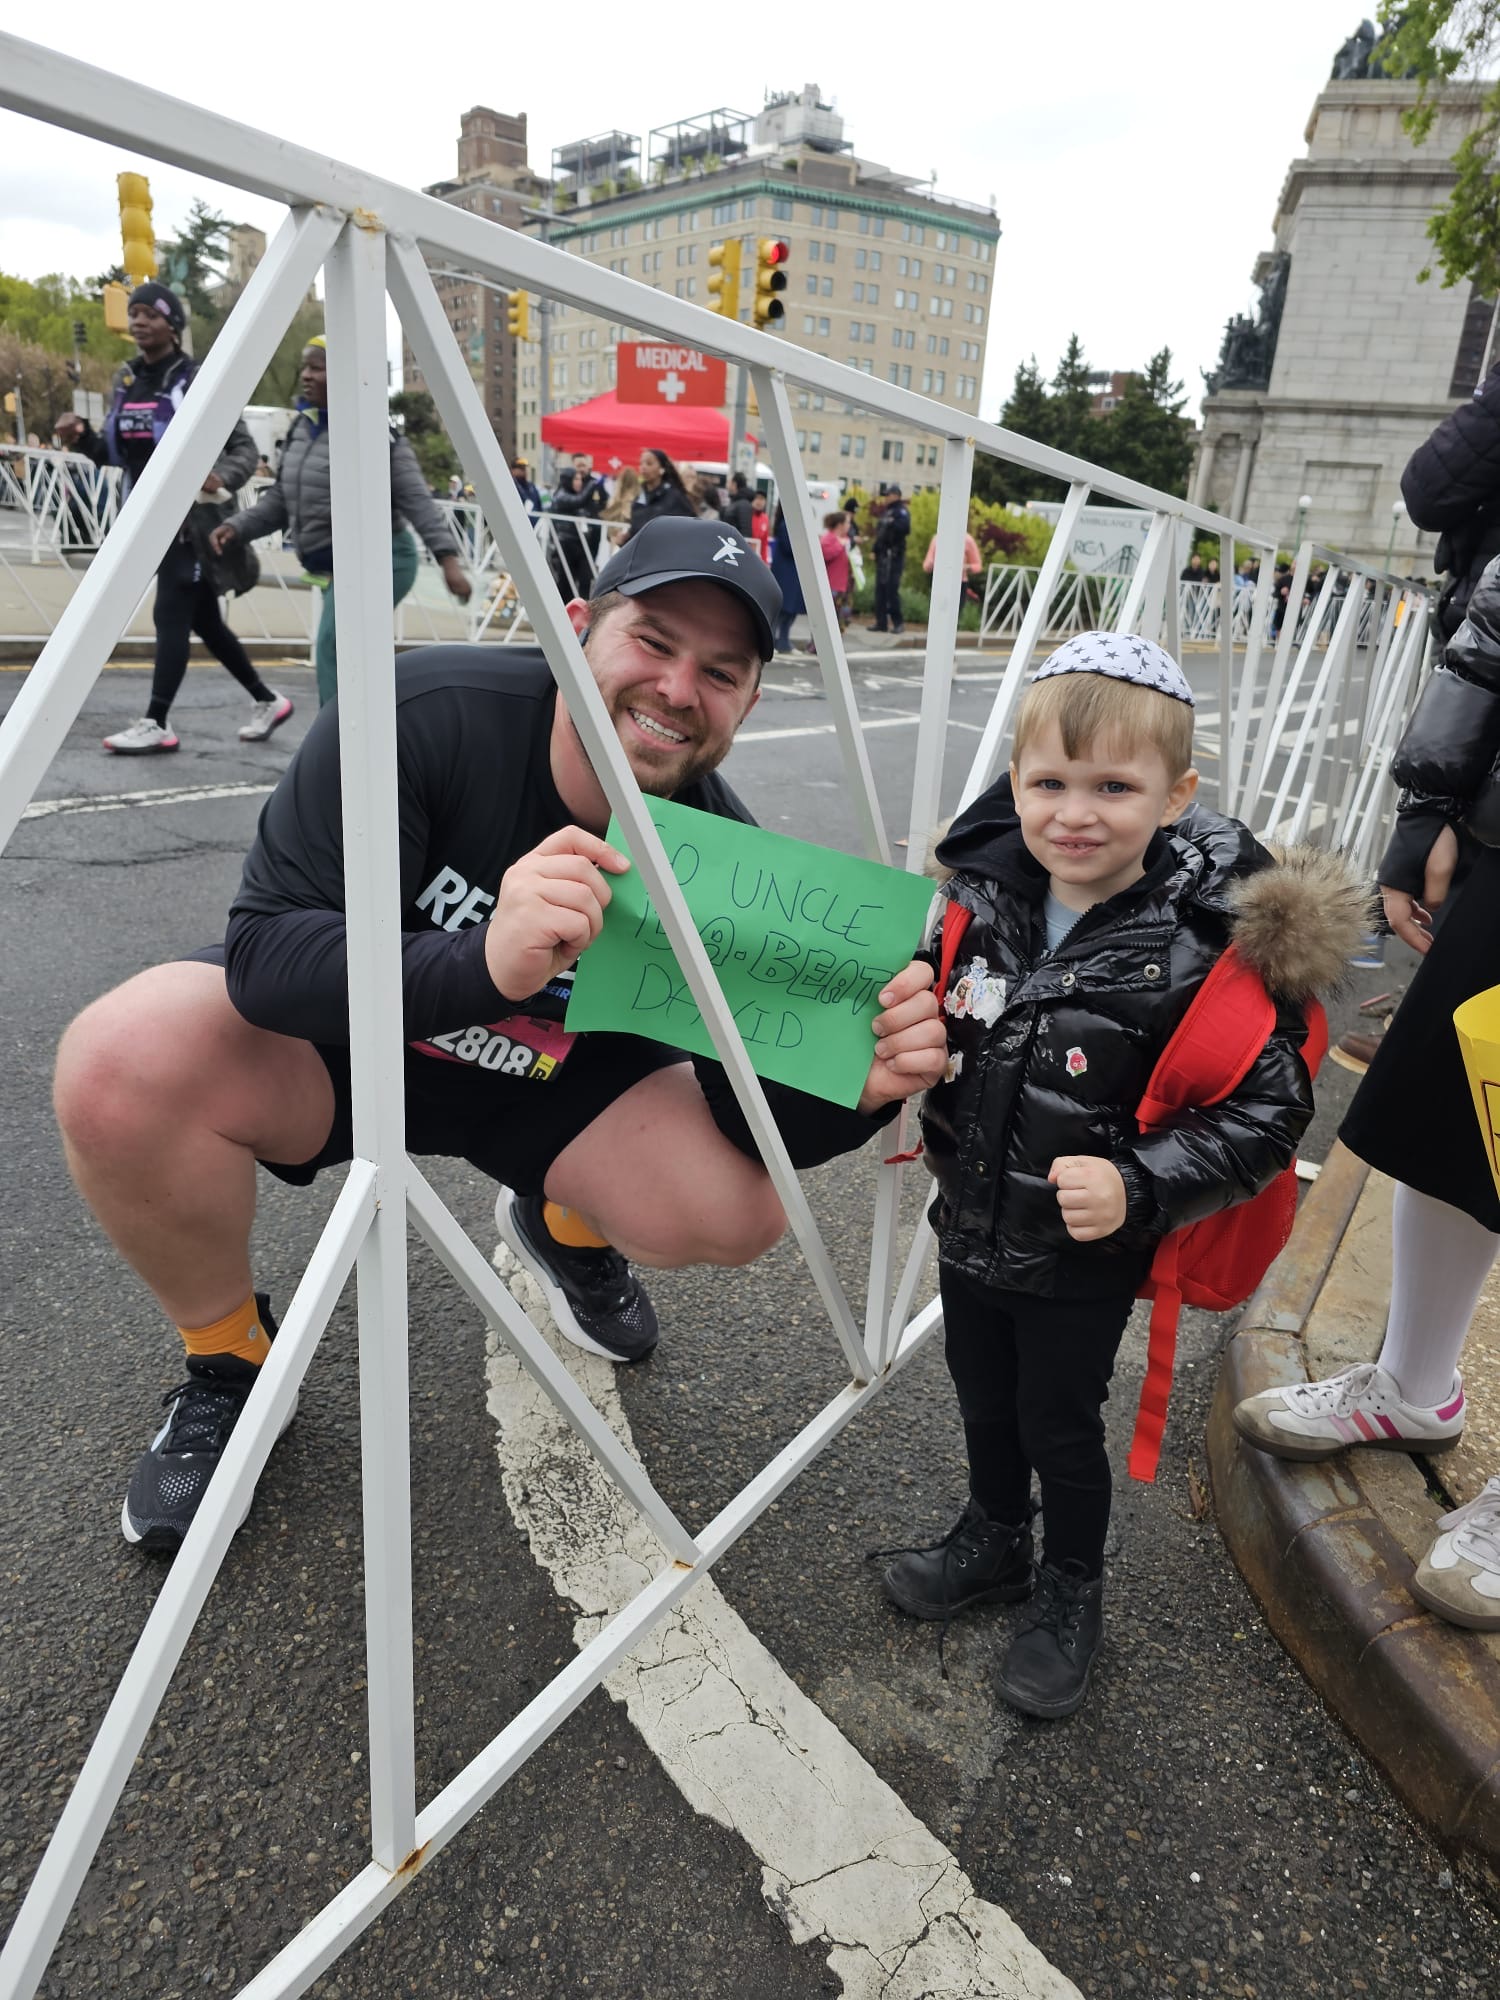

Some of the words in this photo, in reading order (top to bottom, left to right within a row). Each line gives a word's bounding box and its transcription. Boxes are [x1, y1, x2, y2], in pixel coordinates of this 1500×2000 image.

[635, 346, 708, 372] MEDICAL
[415, 865, 496, 932] RE
[653, 823, 700, 886] O
[731, 861, 884, 946] UNCLE
